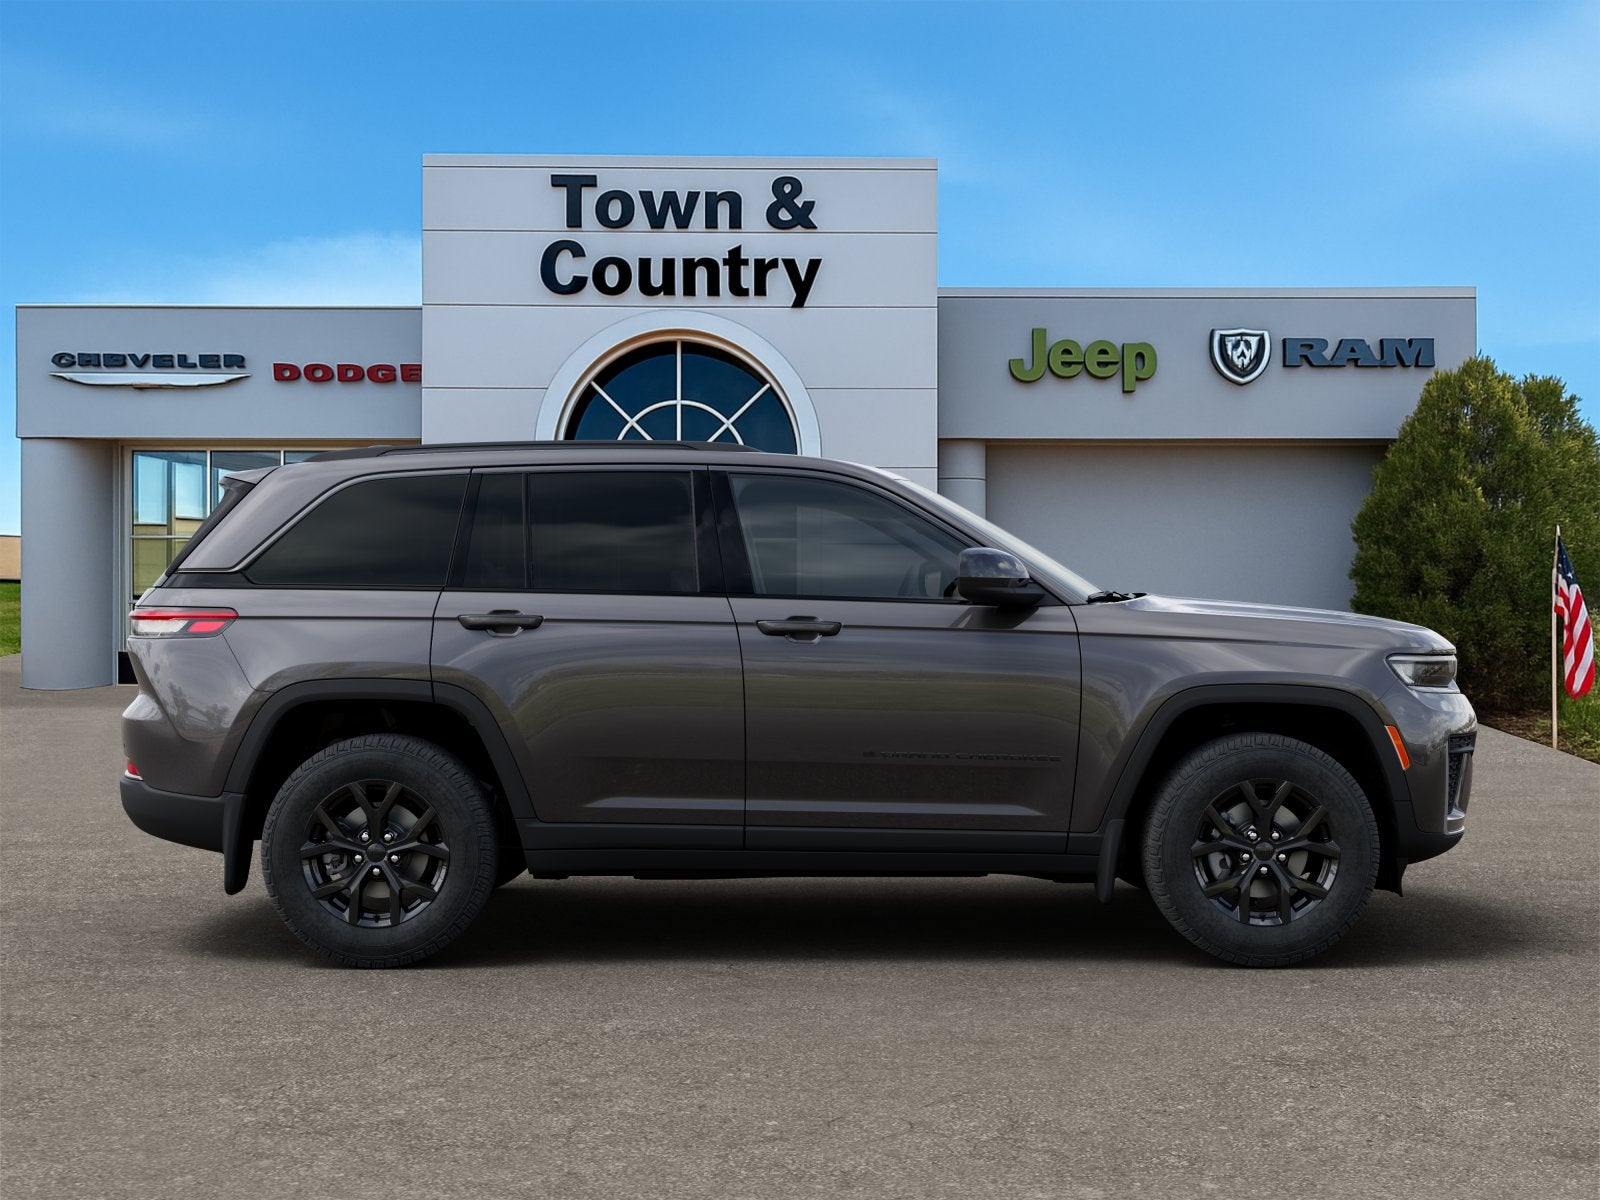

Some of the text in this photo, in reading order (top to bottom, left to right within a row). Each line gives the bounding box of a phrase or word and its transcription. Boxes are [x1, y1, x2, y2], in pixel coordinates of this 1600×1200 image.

[551, 174, 818, 230] Town &
[540, 239, 822, 308] Country
[273, 362, 422, 383] DODGE
[1009, 327, 1158, 393] Jeep
[1282, 337, 1436, 368] RAM
